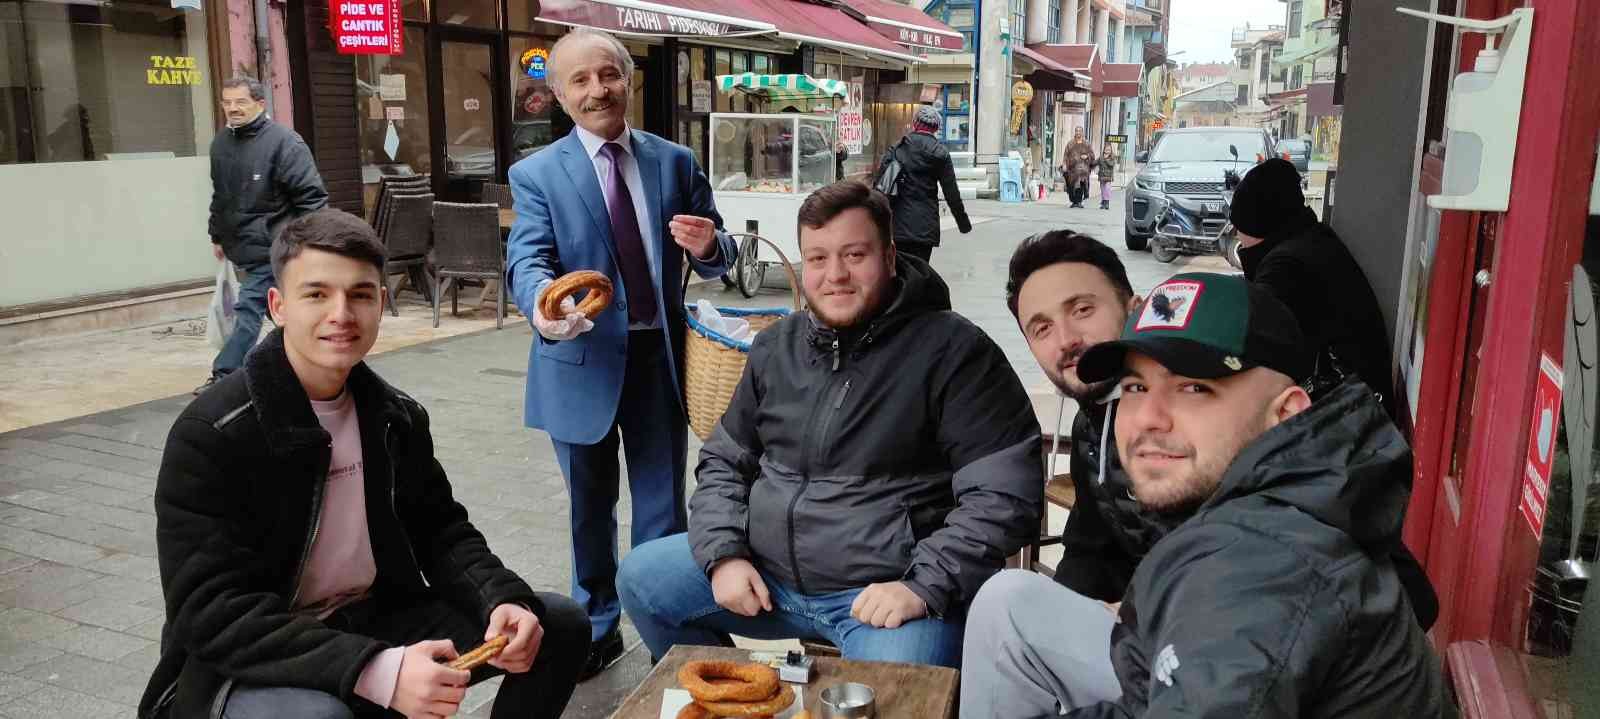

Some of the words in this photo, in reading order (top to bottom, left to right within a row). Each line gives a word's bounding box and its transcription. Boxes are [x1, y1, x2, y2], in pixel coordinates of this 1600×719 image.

[340, 2, 366, 16] PİDE
[368, 3, 384, 16] VE
[341, 19, 385, 32] CANTIK
[339, 33, 389, 48] ÇEŞİTLERİ
[150, 55, 197, 69] TAZE
[146, 69, 202, 85] KAHVE
